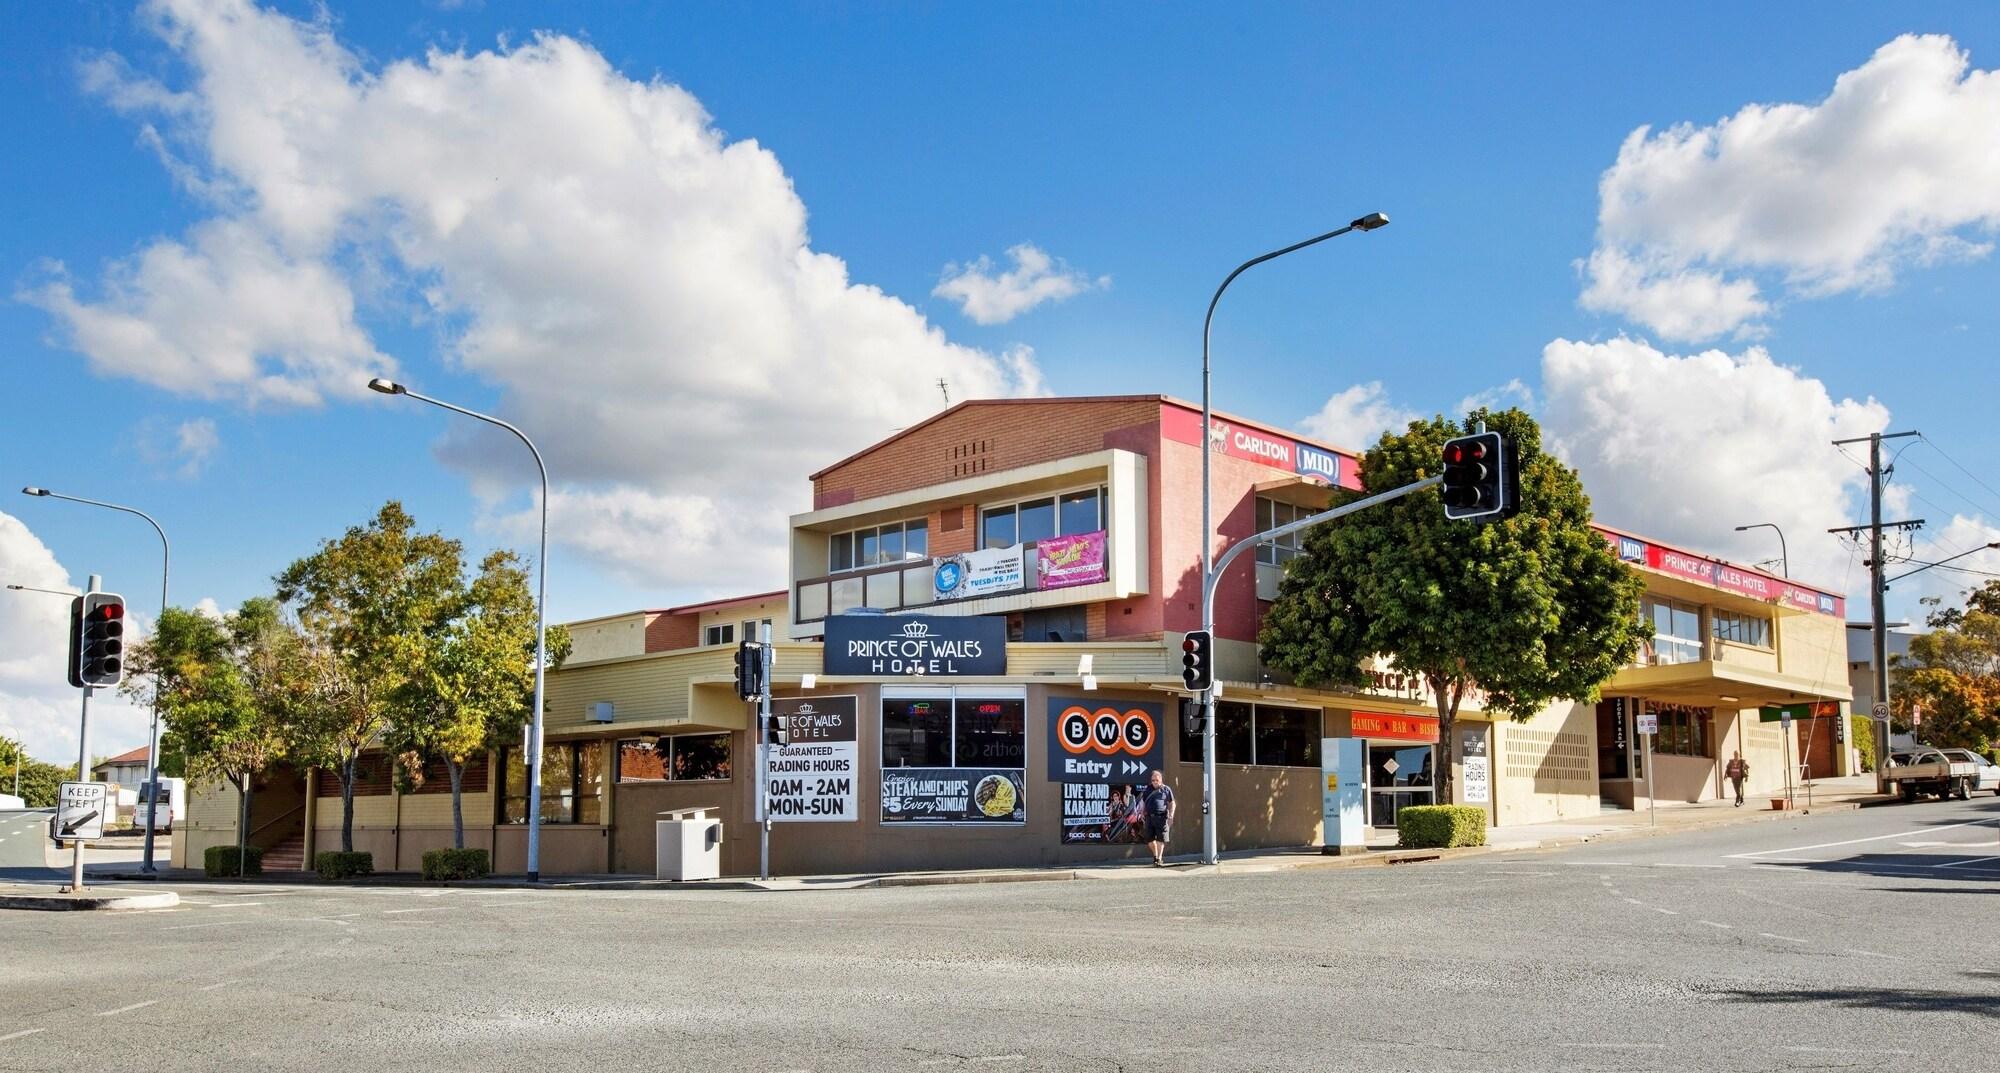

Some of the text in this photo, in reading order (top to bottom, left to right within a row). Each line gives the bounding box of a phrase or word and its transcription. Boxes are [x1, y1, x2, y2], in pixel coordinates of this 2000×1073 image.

[1234, 432, 1288, 462] CARLTON
[1303, 450, 1334, 476] MID
[1622, 541, 1641, 559] MID
[1664, 554, 1698, 575] PRINCE
[1700, 564, 1712, 577] OF
[1742, 575, 1768, 593] HOTEL
[848, 640, 982, 658] PRINCE OF WALES
[872, 659, 958, 673] HOTEL
[979, 704, 1002, 713] OPEN
[1875, 707, 1886, 715] 60
[798, 716, 813, 727] OF
[813, 714, 842, 727] WALES
[1352, 717, 1380, 731] GAMING
[1392, 720, 1407, 733] BAR
[793, 728, 829, 738] OTEL
[1071, 722, 1142, 740] BWS
[779, 747, 833, 756] GUARANTEED
[769, 759, 850, 772] RADING HOURS
[1065, 759, 1112, 778] Entry
[1465, 771, 1486, 781] HOURS
[68, 787, 99, 797] KEEP
[770, 779, 803, 796] 0AM
[816, 779, 850, 796] 2AM
[883, 780, 969, 796] STEAK AND CHIPS
[1064, 783, 1109, 799] LIVE BAND
[68, 800, 96, 808] LEFT
[769, 798, 844, 815] MON-SUN
[883, 796, 969, 814] $5 Every SUNDAY
[1064, 800, 1110, 815] KARAOKE
